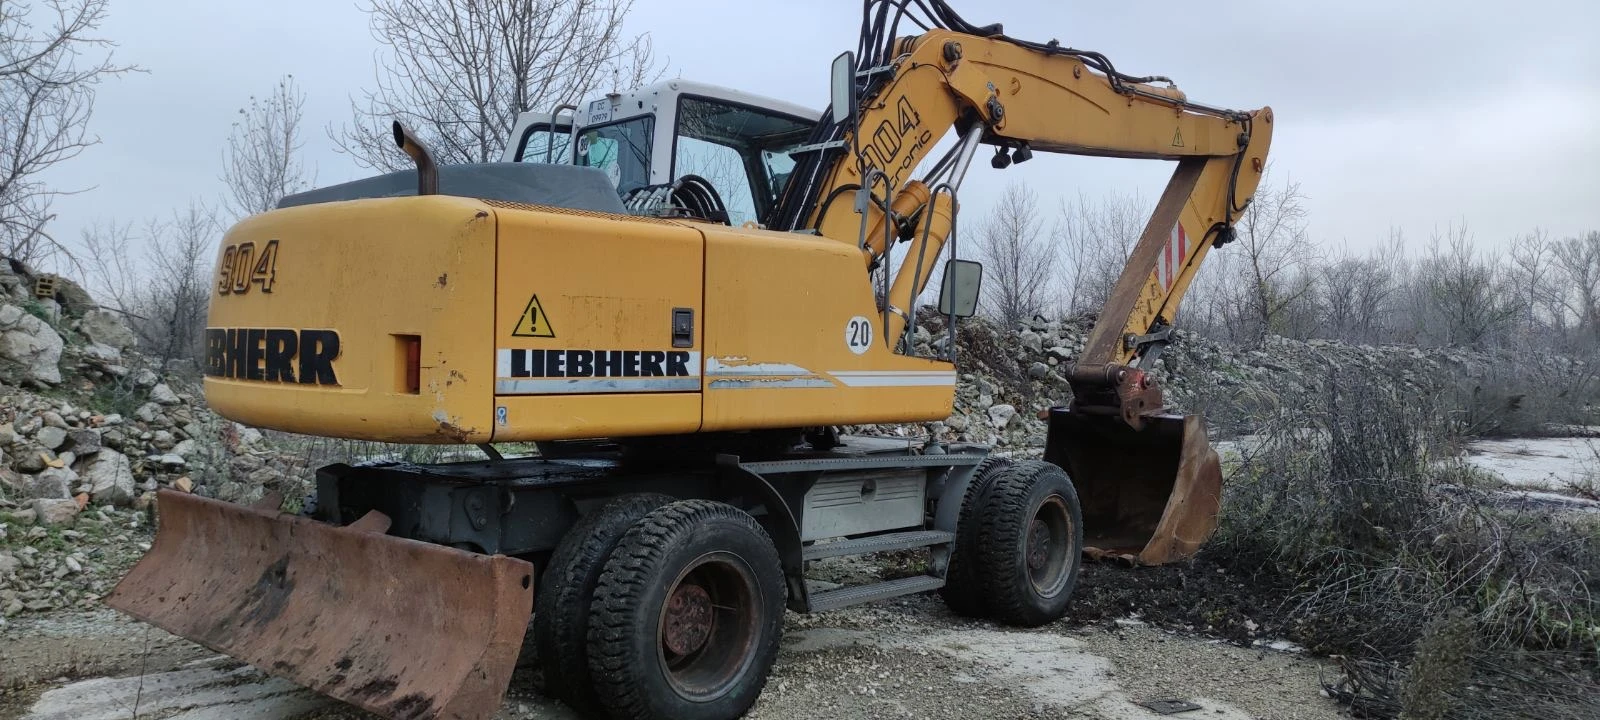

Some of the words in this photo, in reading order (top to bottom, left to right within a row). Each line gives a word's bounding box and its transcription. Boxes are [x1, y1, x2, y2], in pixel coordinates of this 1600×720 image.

[856, 94, 921, 189] 904
[218, 239, 280, 295] 904
[850, 320, 870, 347] 20
[511, 349, 690, 378] LIEBHERR
